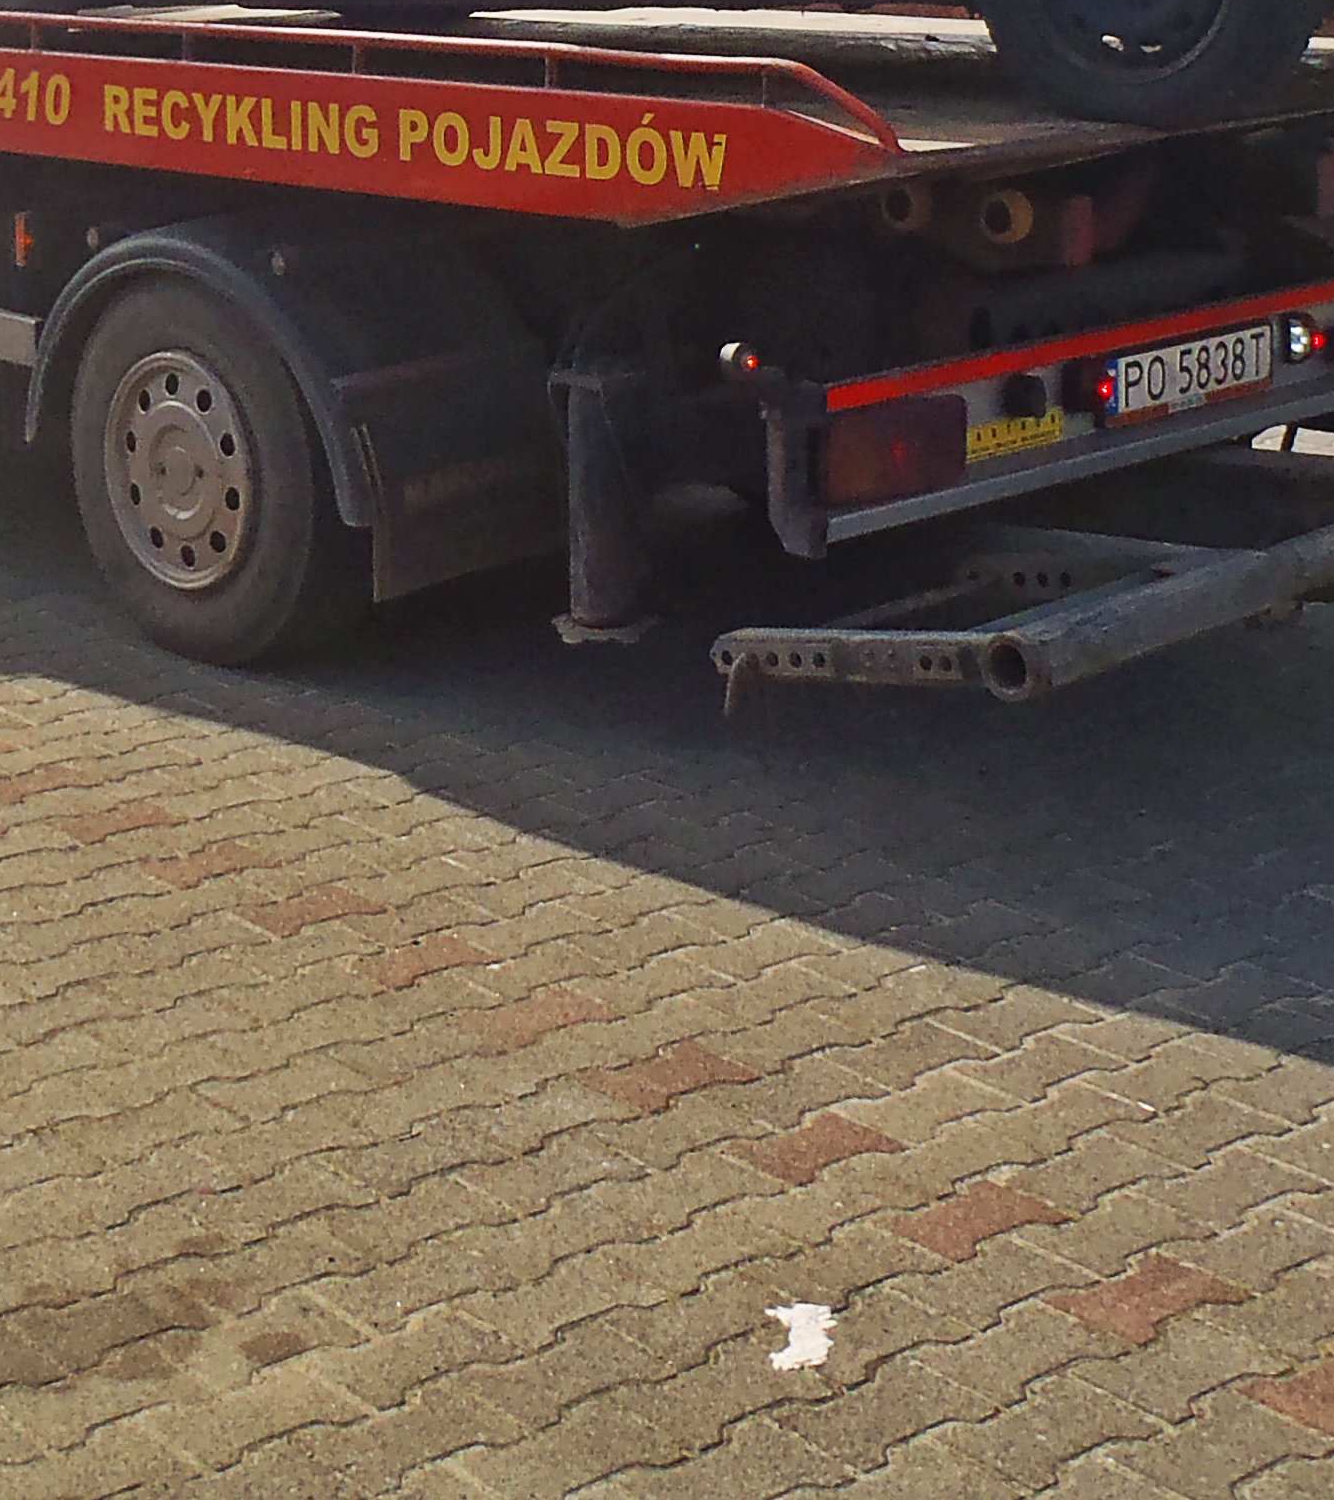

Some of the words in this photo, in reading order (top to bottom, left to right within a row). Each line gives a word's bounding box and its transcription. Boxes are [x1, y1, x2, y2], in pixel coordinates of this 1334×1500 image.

[103, 85, 379, 158] RECYKLING
[399, 109, 727, 191] POJAZDÓW
[1124, 355, 1166, 408] PO
[1177, 332, 1265, 394] 5838T
